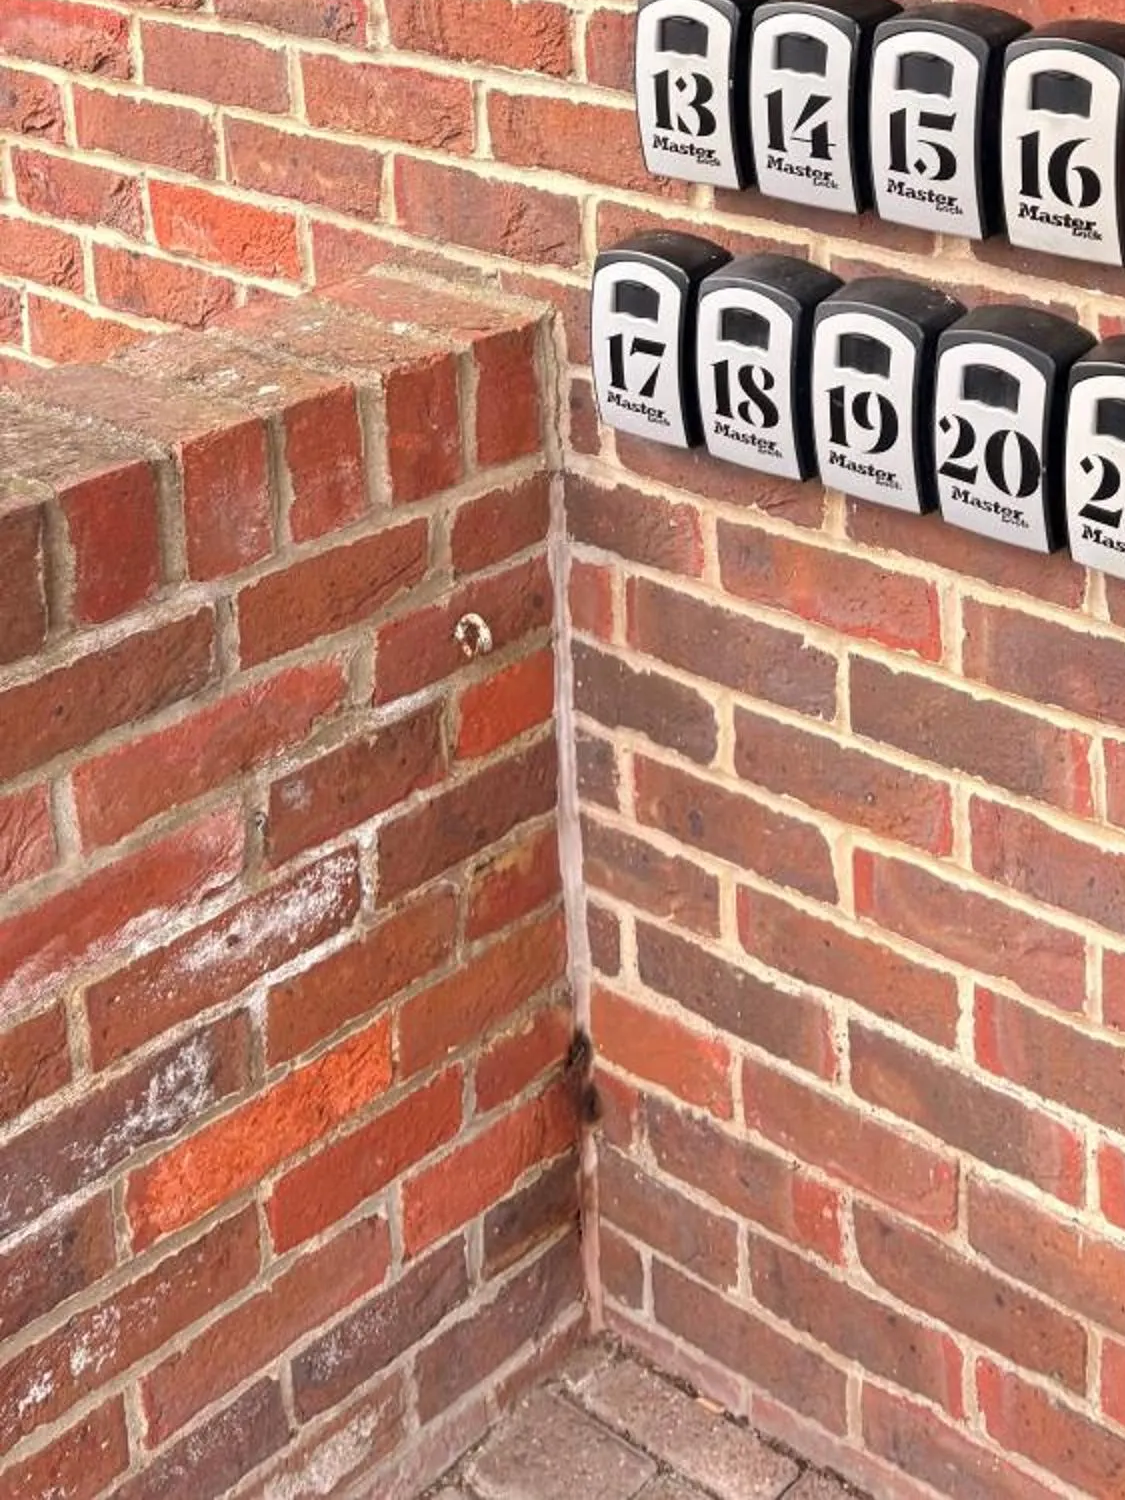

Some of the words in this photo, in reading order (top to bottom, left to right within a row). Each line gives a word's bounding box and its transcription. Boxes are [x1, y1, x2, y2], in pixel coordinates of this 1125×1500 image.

[653, 69, 718, 137] 13
[764, 88, 836, 160] 14
[653, 134, 716, 160] Master
[766, 155, 834, 183] Master
[888, 108, 958, 181] 15
[1018, 130, 1101, 208] 16
[887, 180, 958, 208] Master
[1018, 203, 1097, 232] Master
[607, 333, 667, 398] 17
[607, 391, 666, 423] Master
[710, 359, 780, 429] 18
[714, 421, 778, 452] Master
[825, 384, 899, 455] 19
[828, 450, 897, 483] Master
[938, 413, 1041, 499] 20
[951, 485, 1025, 521] Master
